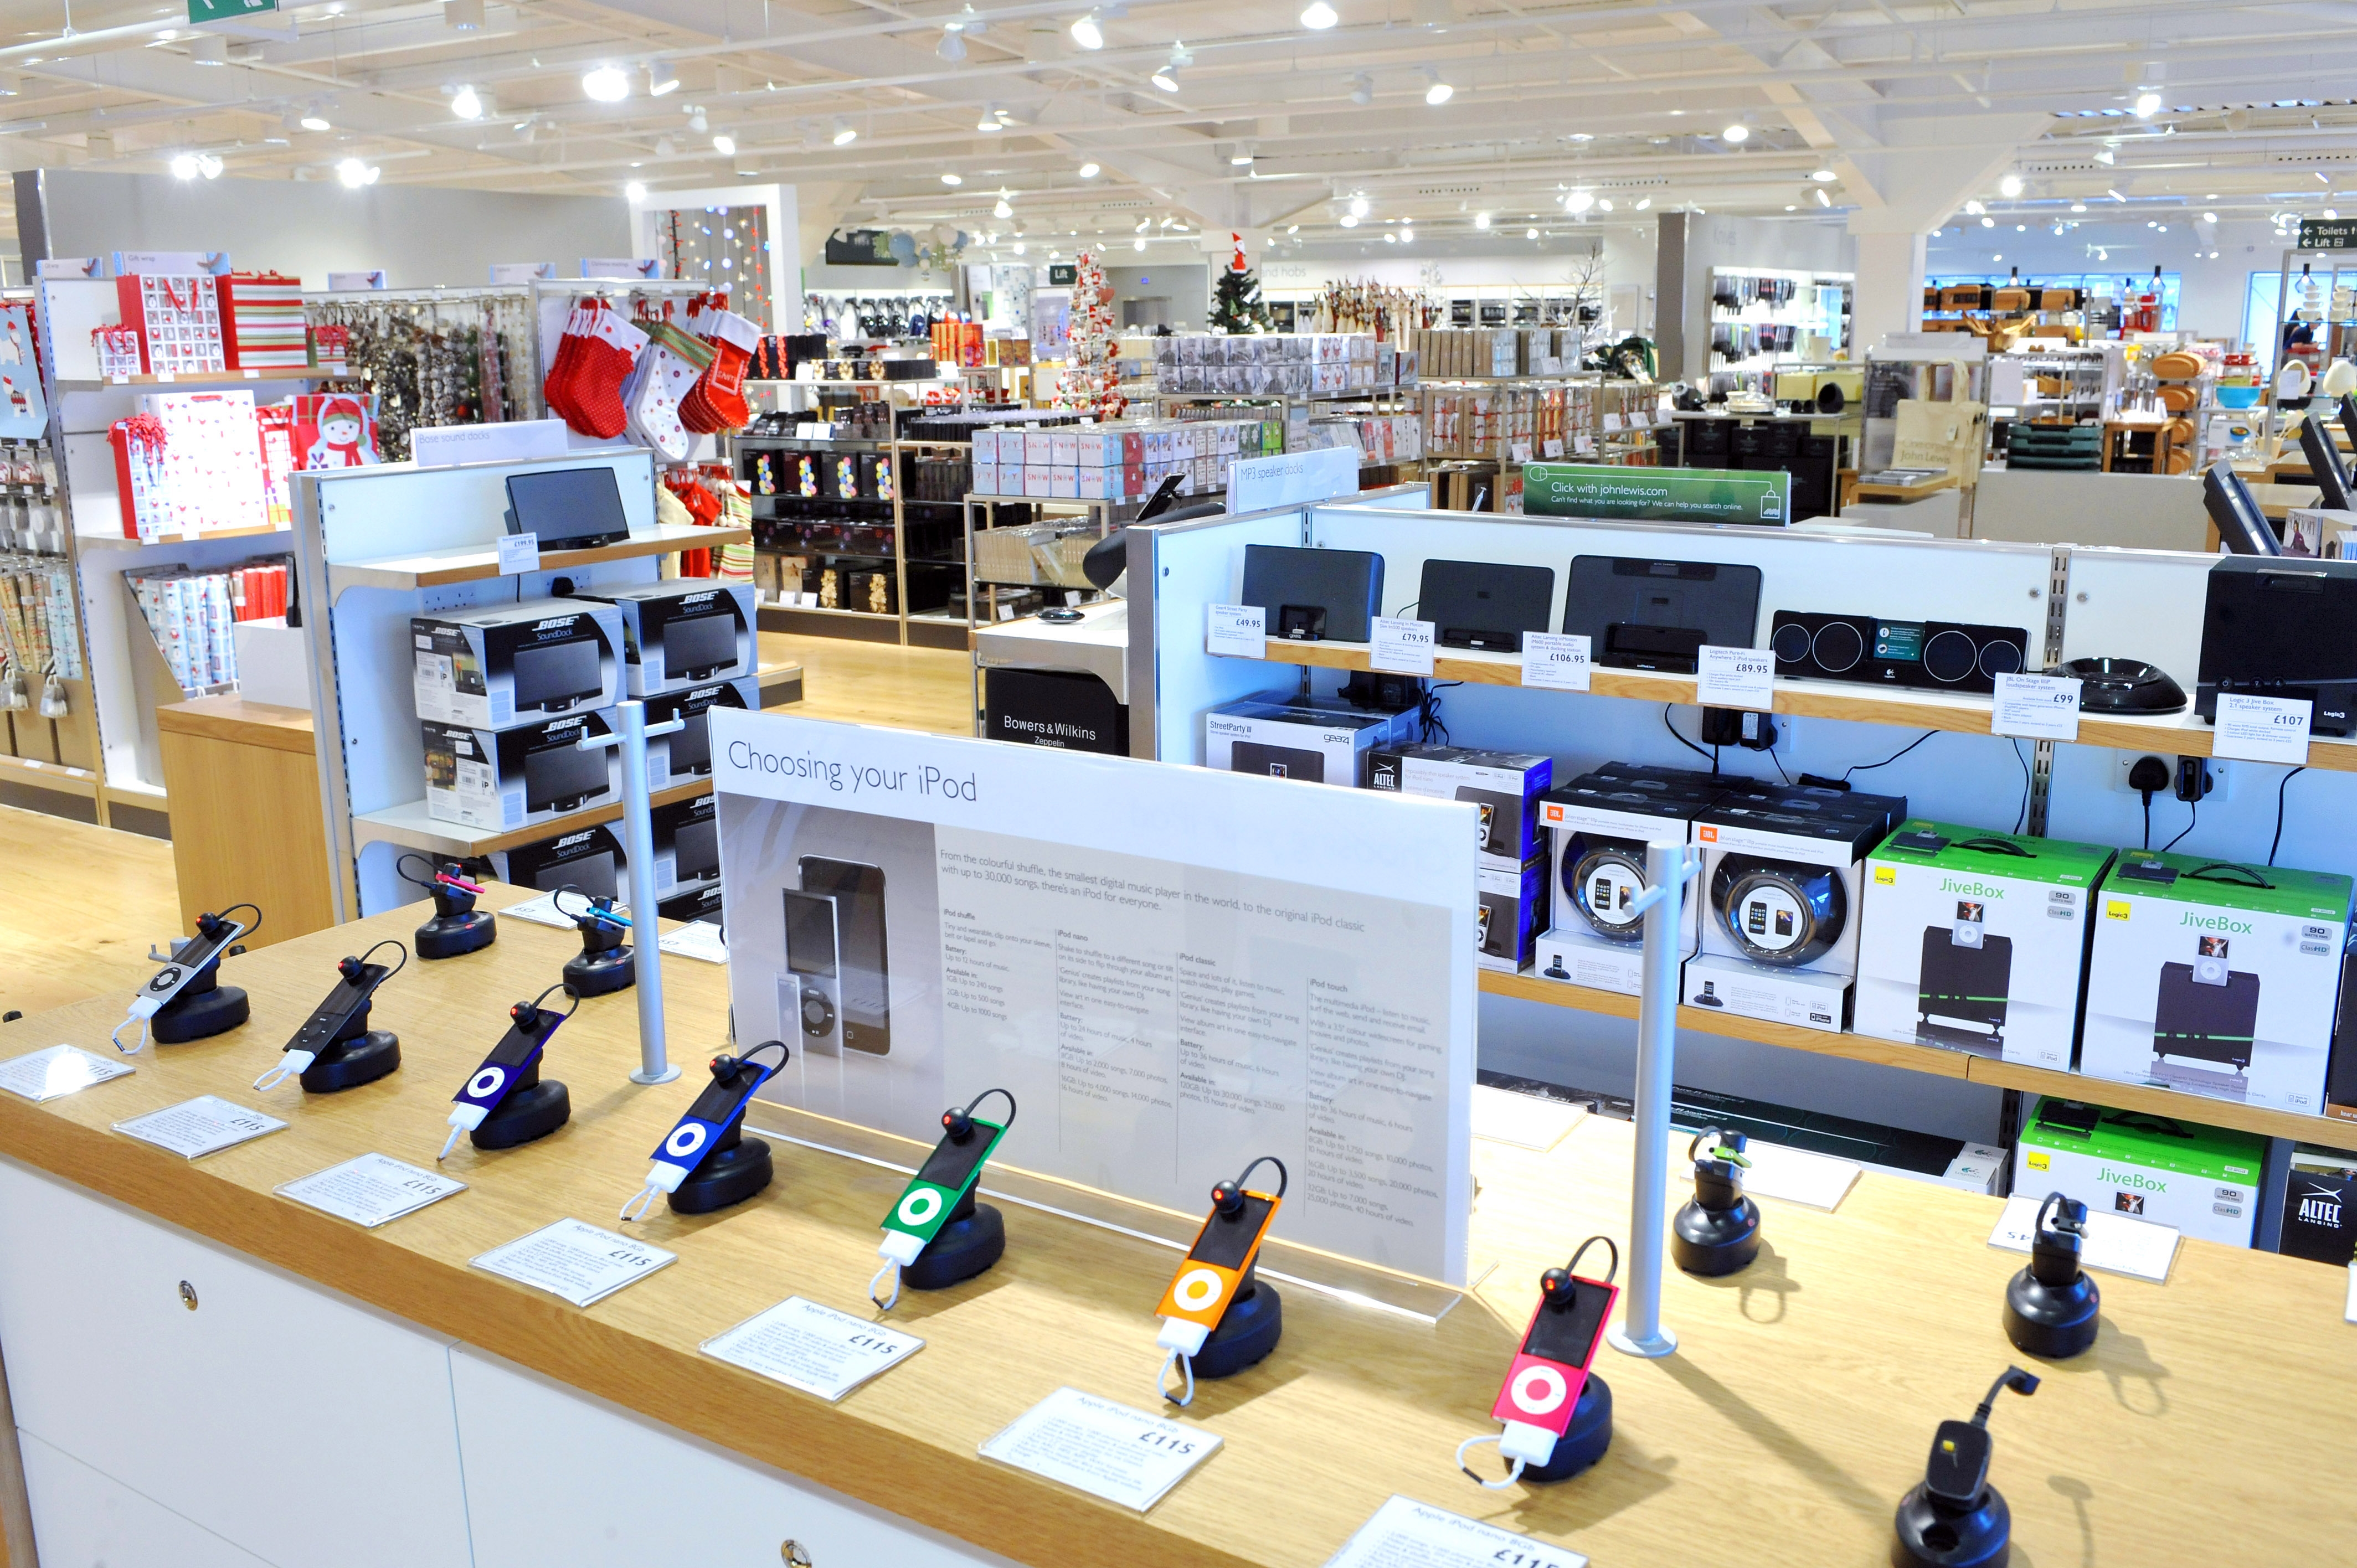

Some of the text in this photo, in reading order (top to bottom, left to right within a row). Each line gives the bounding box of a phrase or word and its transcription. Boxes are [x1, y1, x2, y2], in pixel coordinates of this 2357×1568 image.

[2317, 226, 2348, 235] Toilets
[2315, 238, 2330, 247] Lift
[1055, 269, 1068, 279] Lift
[419, 431, 490, 443] Bose sound docks
[1241, 462, 1303, 481] MP3 speaker docks
[1551, 482, 1668, 496] Click with johnlewis.com
[1617, 499, 1638, 507] looking
[1676, 501, 1689, 509] help
[679, 591, 718, 605] BOSE
[683, 602, 713, 615] SoundDock
[532, 616, 579, 632] BOSE
[1236, 618, 1260, 628] £49.95
[537, 628, 573, 641] SoundDock
[1402, 633, 1429, 643] £79.95
[1550, 653, 1584, 663] £106.95
[1736, 663, 1768, 674] £89.95
[684, 685, 723, 702] BOSE
[2054, 694, 2073, 704] £99
[688, 698, 717, 710] SoundDock
[542, 715, 586, 734] BOSE
[1210, 720, 1246, 733] StreetParty
[2273, 715, 2303, 725] £107
[1004, 715, 1096, 740] Bowers & Wilkins
[547, 729, 581, 741] SoundDock
[1035, 736, 1064, 747] Zeppelin
[1324, 734, 1349, 745] gear4
[728, 740, 977, 802] Choosing your iPod
[1373, 772, 1395, 787] ALTEC
[1550, 809, 1561, 818] JBL
[552, 829, 595, 849] BOSE
[1703, 831, 1714, 839] JBL
[557, 843, 590, 858] SoundDock
[940, 849, 1365, 932] From the colourful shuffle, the smallest digital music player in the world, to the original iPod classic
[941, 865, 1161, 910] with up to 30,000 songs, there's an iPod for everyone.
[1939, 878, 2005, 899] JiveBox
[944, 909, 975, 920] iPod shuffle
[2108, 911, 2128, 919] Logic3
[2180, 912, 2252, 934] JiveBox
[1058, 930, 1071, 938] iPod
[1180, 953, 1216, 967] iPod classic
[1310, 979, 1347, 993] iPod touch
[230, 1118, 266, 1131] £115
[2029, 1160, 2048, 1169] Logic3
[2097, 1167, 2167, 1193] JiveBox
[403, 1180, 441, 1195] £115
[2298, 1199, 2343, 1224] ALTEC
[2298, 1217, 2341, 1229] LANSING
[609, 1250, 652, 1266] £115
[802, 1304, 826, 1316] Apple
[826, 1312, 846, 1323] iPod
[848, 1334, 898, 1354] £115
[1139, 1431, 1196, 1454] £115
